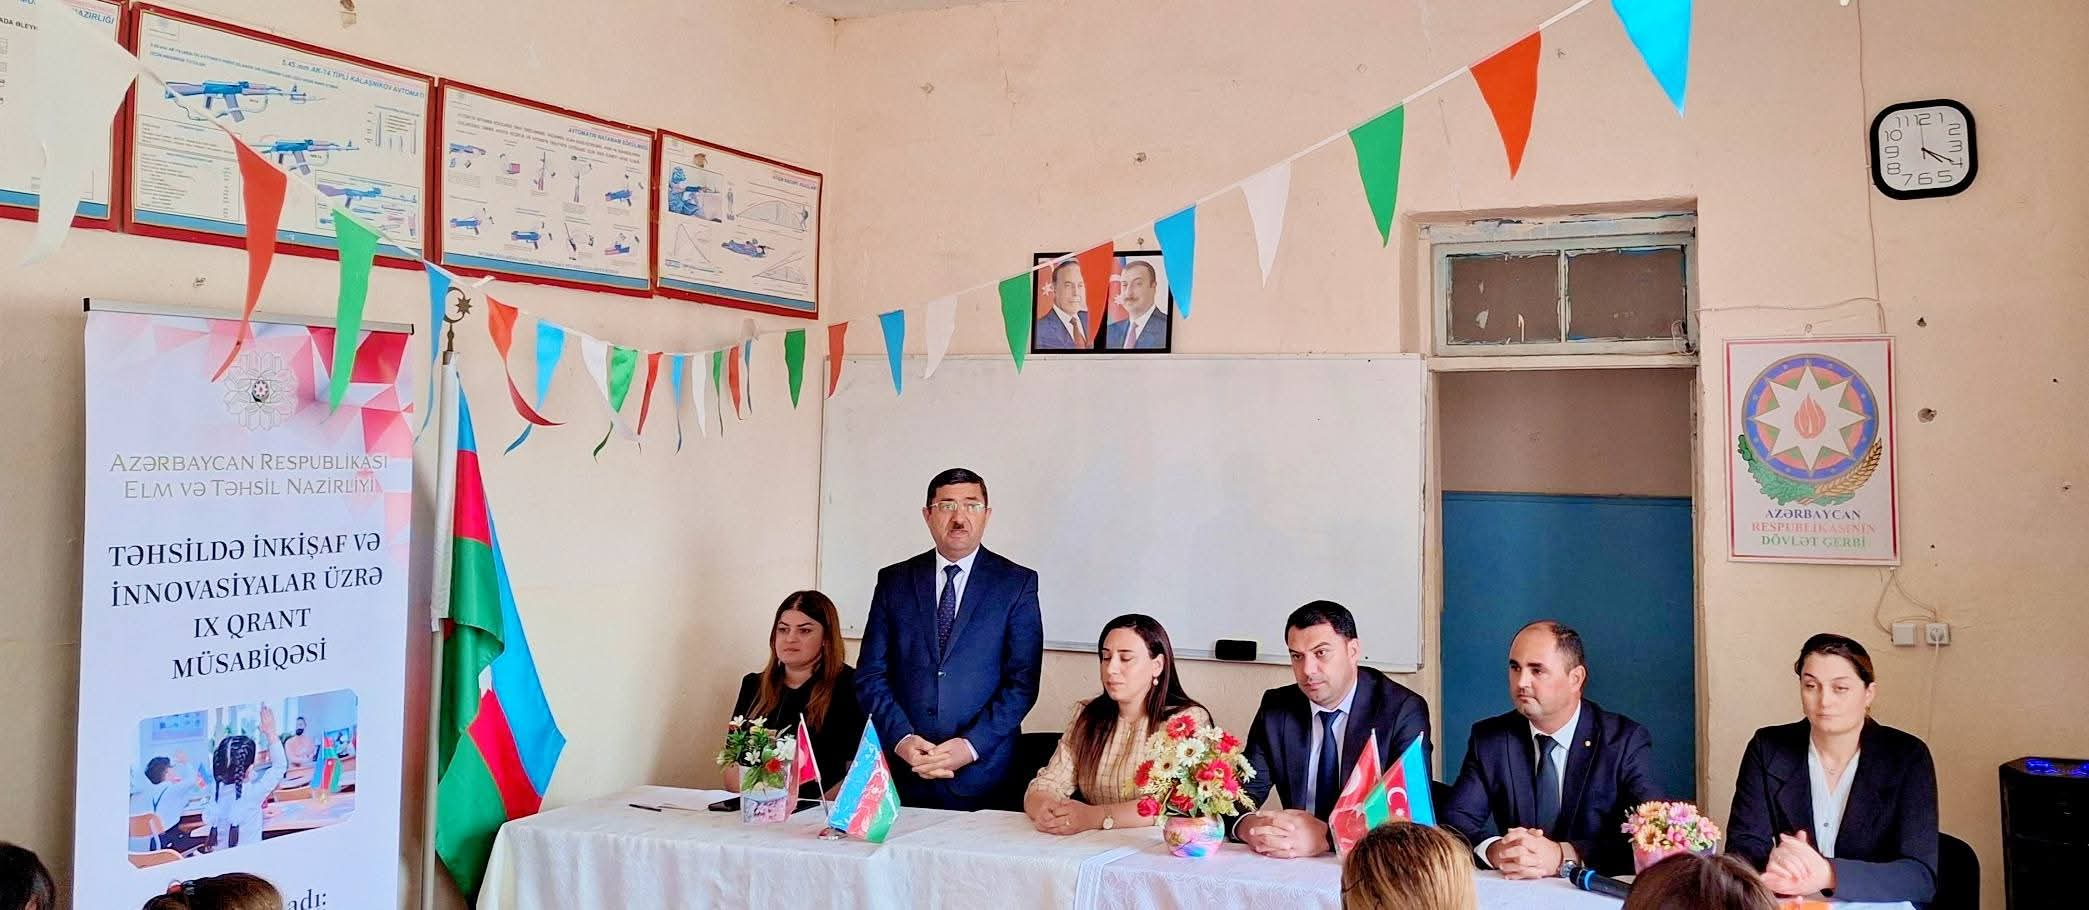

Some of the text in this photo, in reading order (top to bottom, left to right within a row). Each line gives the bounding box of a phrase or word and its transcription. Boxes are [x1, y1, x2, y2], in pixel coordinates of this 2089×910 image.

[1896, 115, 1910, 128] 11
[1913, 113, 1931, 126] 12
[1884, 129, 1903, 142] 10
[1948, 123, 1961, 136] 2
[1884, 145, 1899, 159] 9
[1948, 140, 1963, 153] 3
[1887, 162, 1901, 175] 8
[1901, 174, 1913, 186] 7
[1918, 172, 1933, 185] 6
[1937, 170, 1953, 183] 5
[110, 453, 254, 472] AZƏRBAYCAN
[125, 480, 173, 499] ELM
[181, 482, 206, 497] VƏ
[211, 476, 280, 497] TƏHSİL
[1767, 509, 1861, 520] AZƏRBAYCAN
[1762, 533, 1816, 547] DÖVLƏT
[109, 532, 381, 567] TƏHSİLDƏ İNKİŞAF VƏ
[111, 565, 383, 607] İNNOVASİYALAR ÜZRƏ
[193, 608, 312, 639] IX QRANT
[170, 637, 328, 680] MÜSABİQƏSİ
